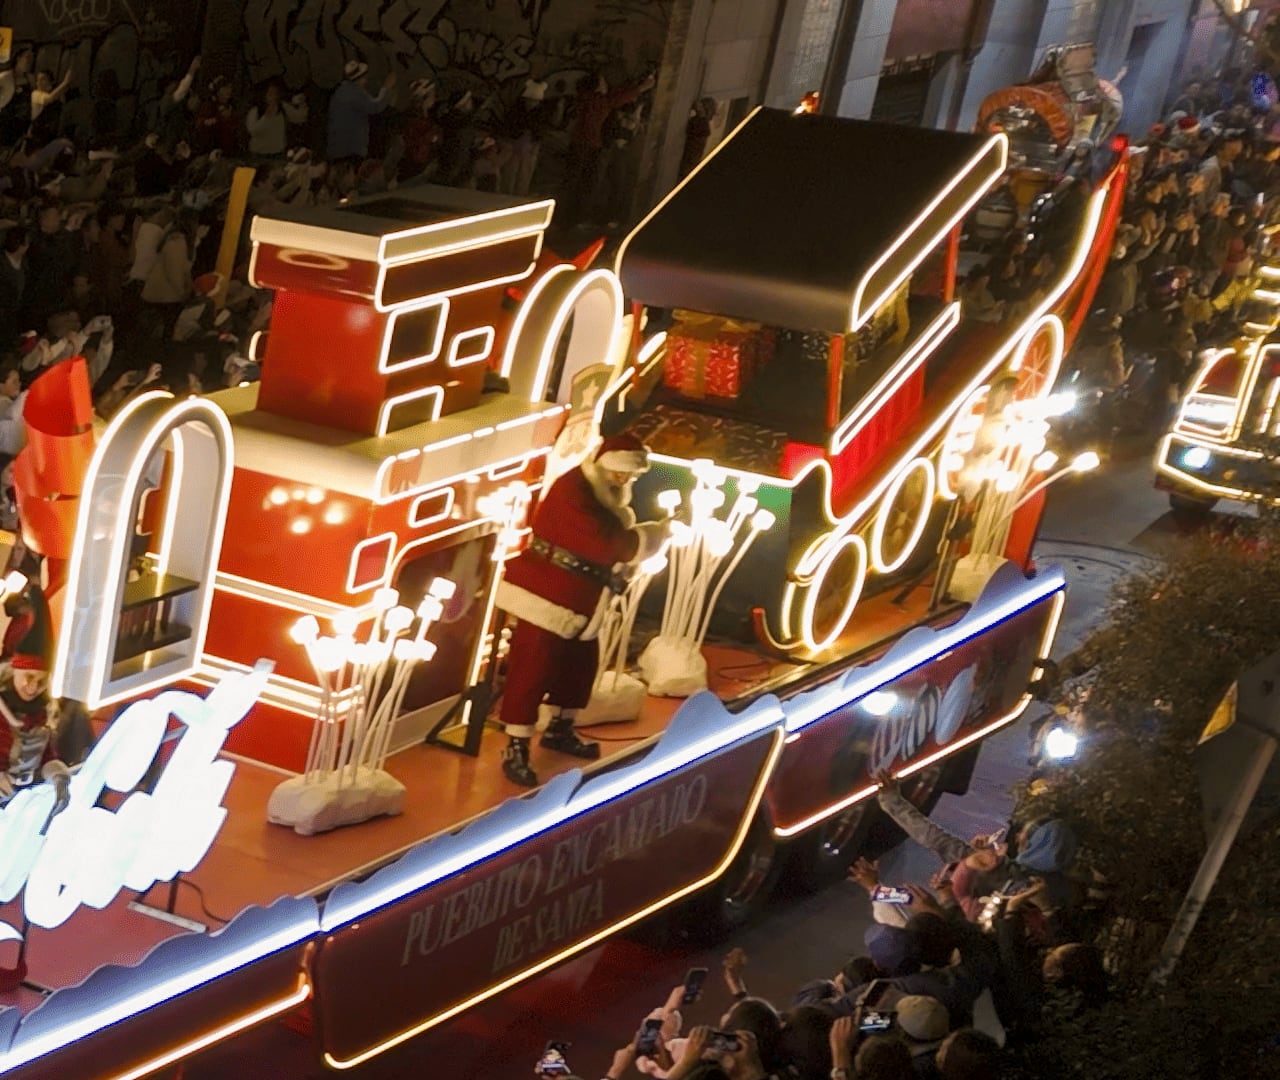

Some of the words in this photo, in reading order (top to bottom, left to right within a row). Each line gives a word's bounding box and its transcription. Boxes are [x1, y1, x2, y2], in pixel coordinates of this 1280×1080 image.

[400, 853, 540, 967] PUEBLITO
[546, 773, 709, 896] ENCANTADO
[491, 915, 530, 974] DE
[529, 877, 606, 953] SANTA
